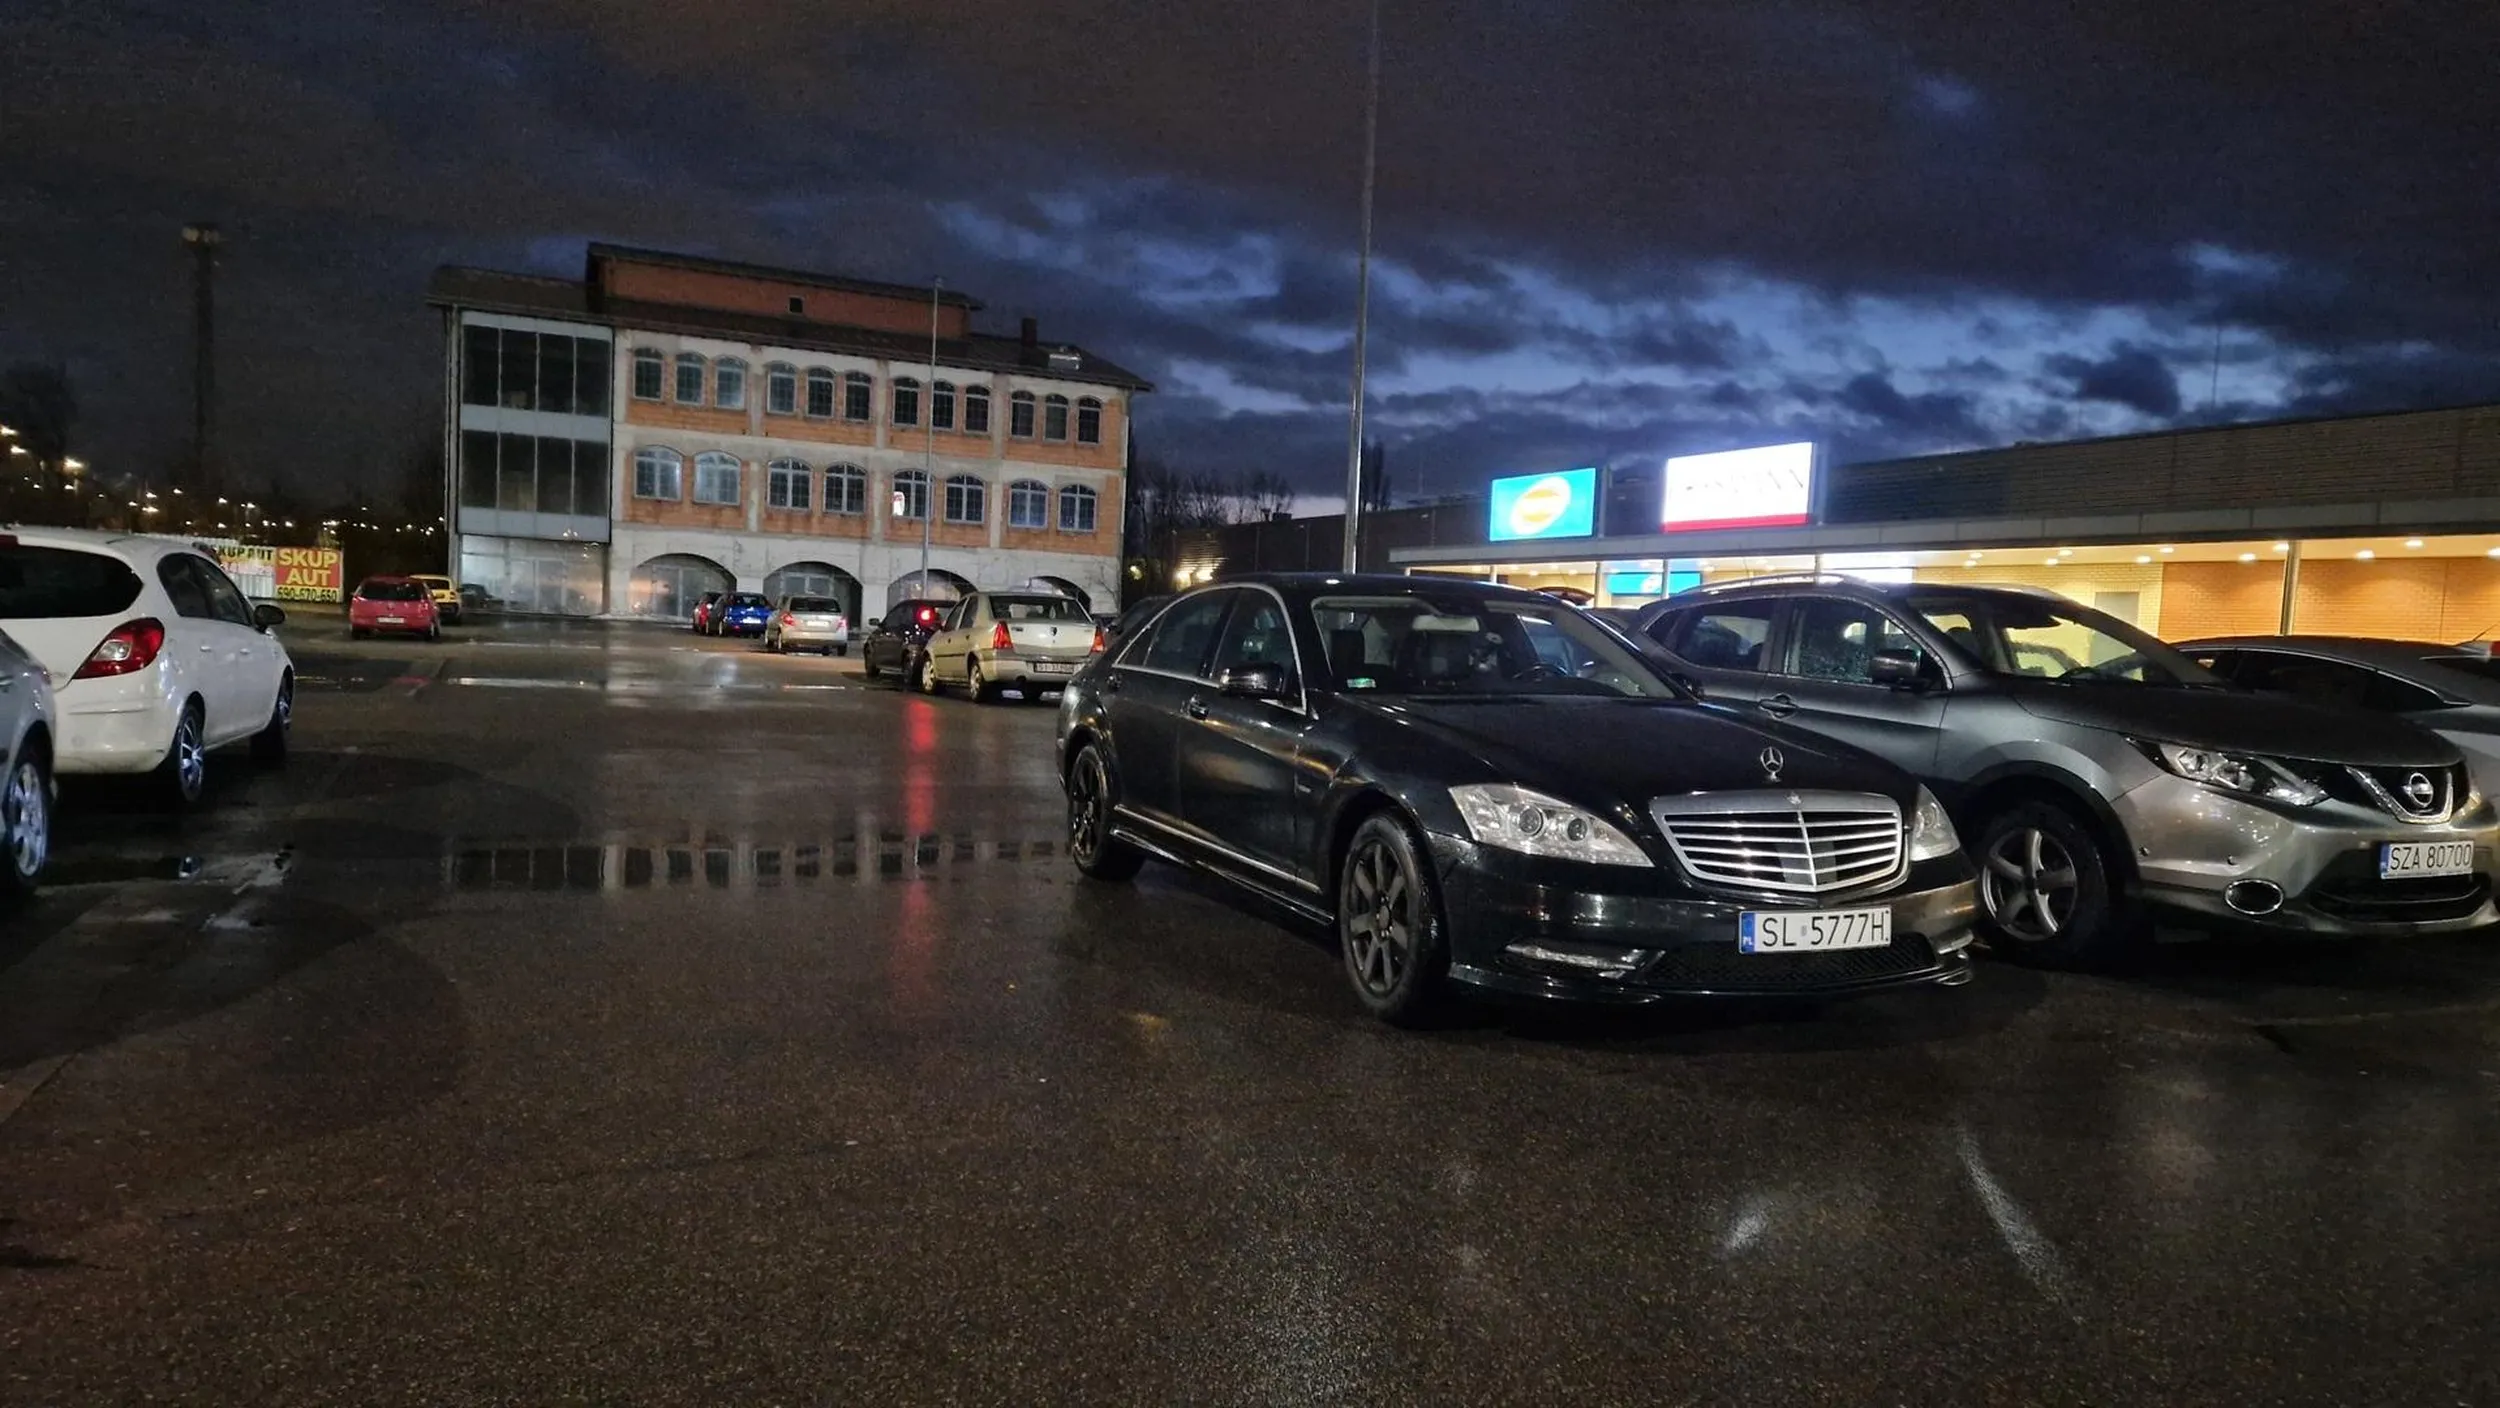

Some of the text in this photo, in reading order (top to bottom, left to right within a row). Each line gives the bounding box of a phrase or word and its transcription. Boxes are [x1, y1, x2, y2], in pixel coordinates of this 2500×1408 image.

[279, 548, 337, 568] SKUP
[286, 568, 332, 586] AUT
[2390, 847, 2421, 870] SZA
[2426, 844, 2472, 868] 80700
[1763, 911, 1884, 947] SL 5777H
